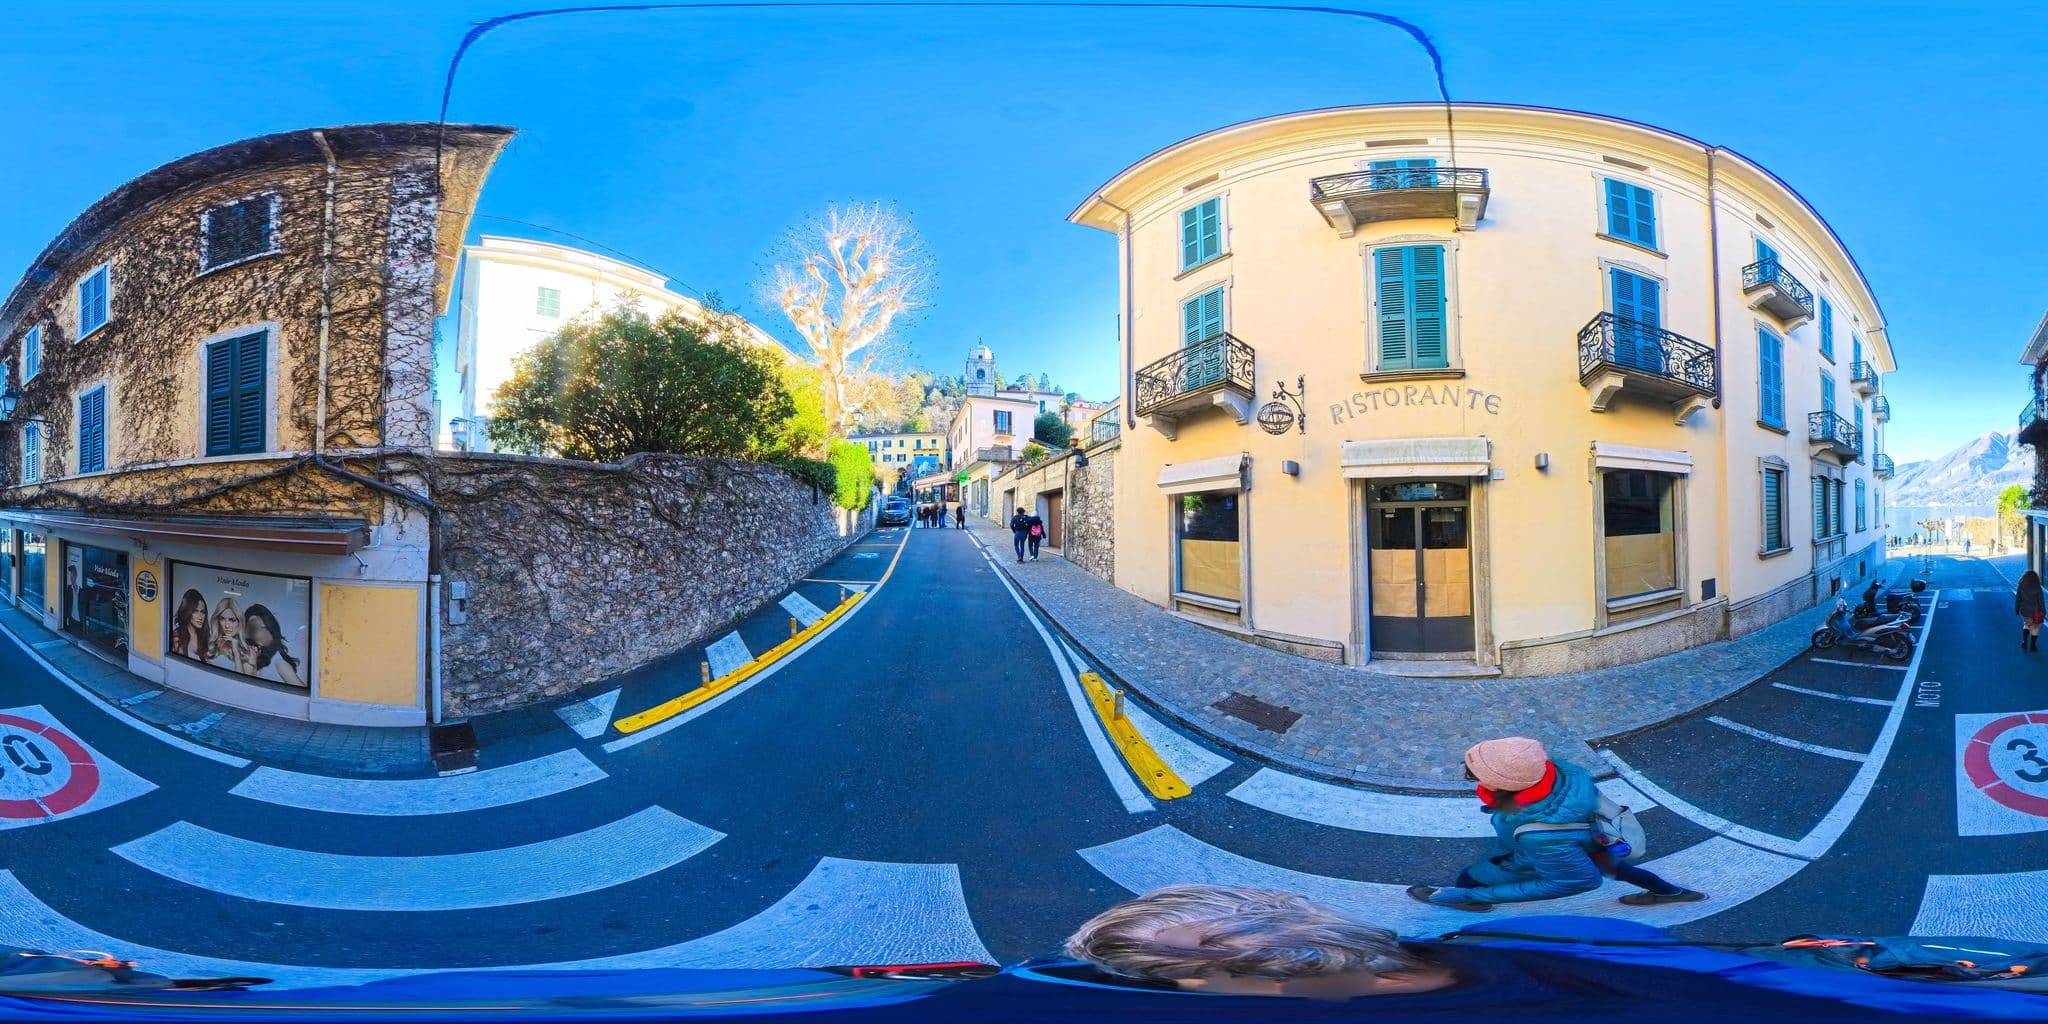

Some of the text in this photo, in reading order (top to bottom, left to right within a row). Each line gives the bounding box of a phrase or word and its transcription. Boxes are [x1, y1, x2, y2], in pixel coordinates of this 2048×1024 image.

[1330, 385, 1502, 424] RISTORANTE
[1915, 681, 1941, 707] MOTO
[0, 735, 52, 779] 0
